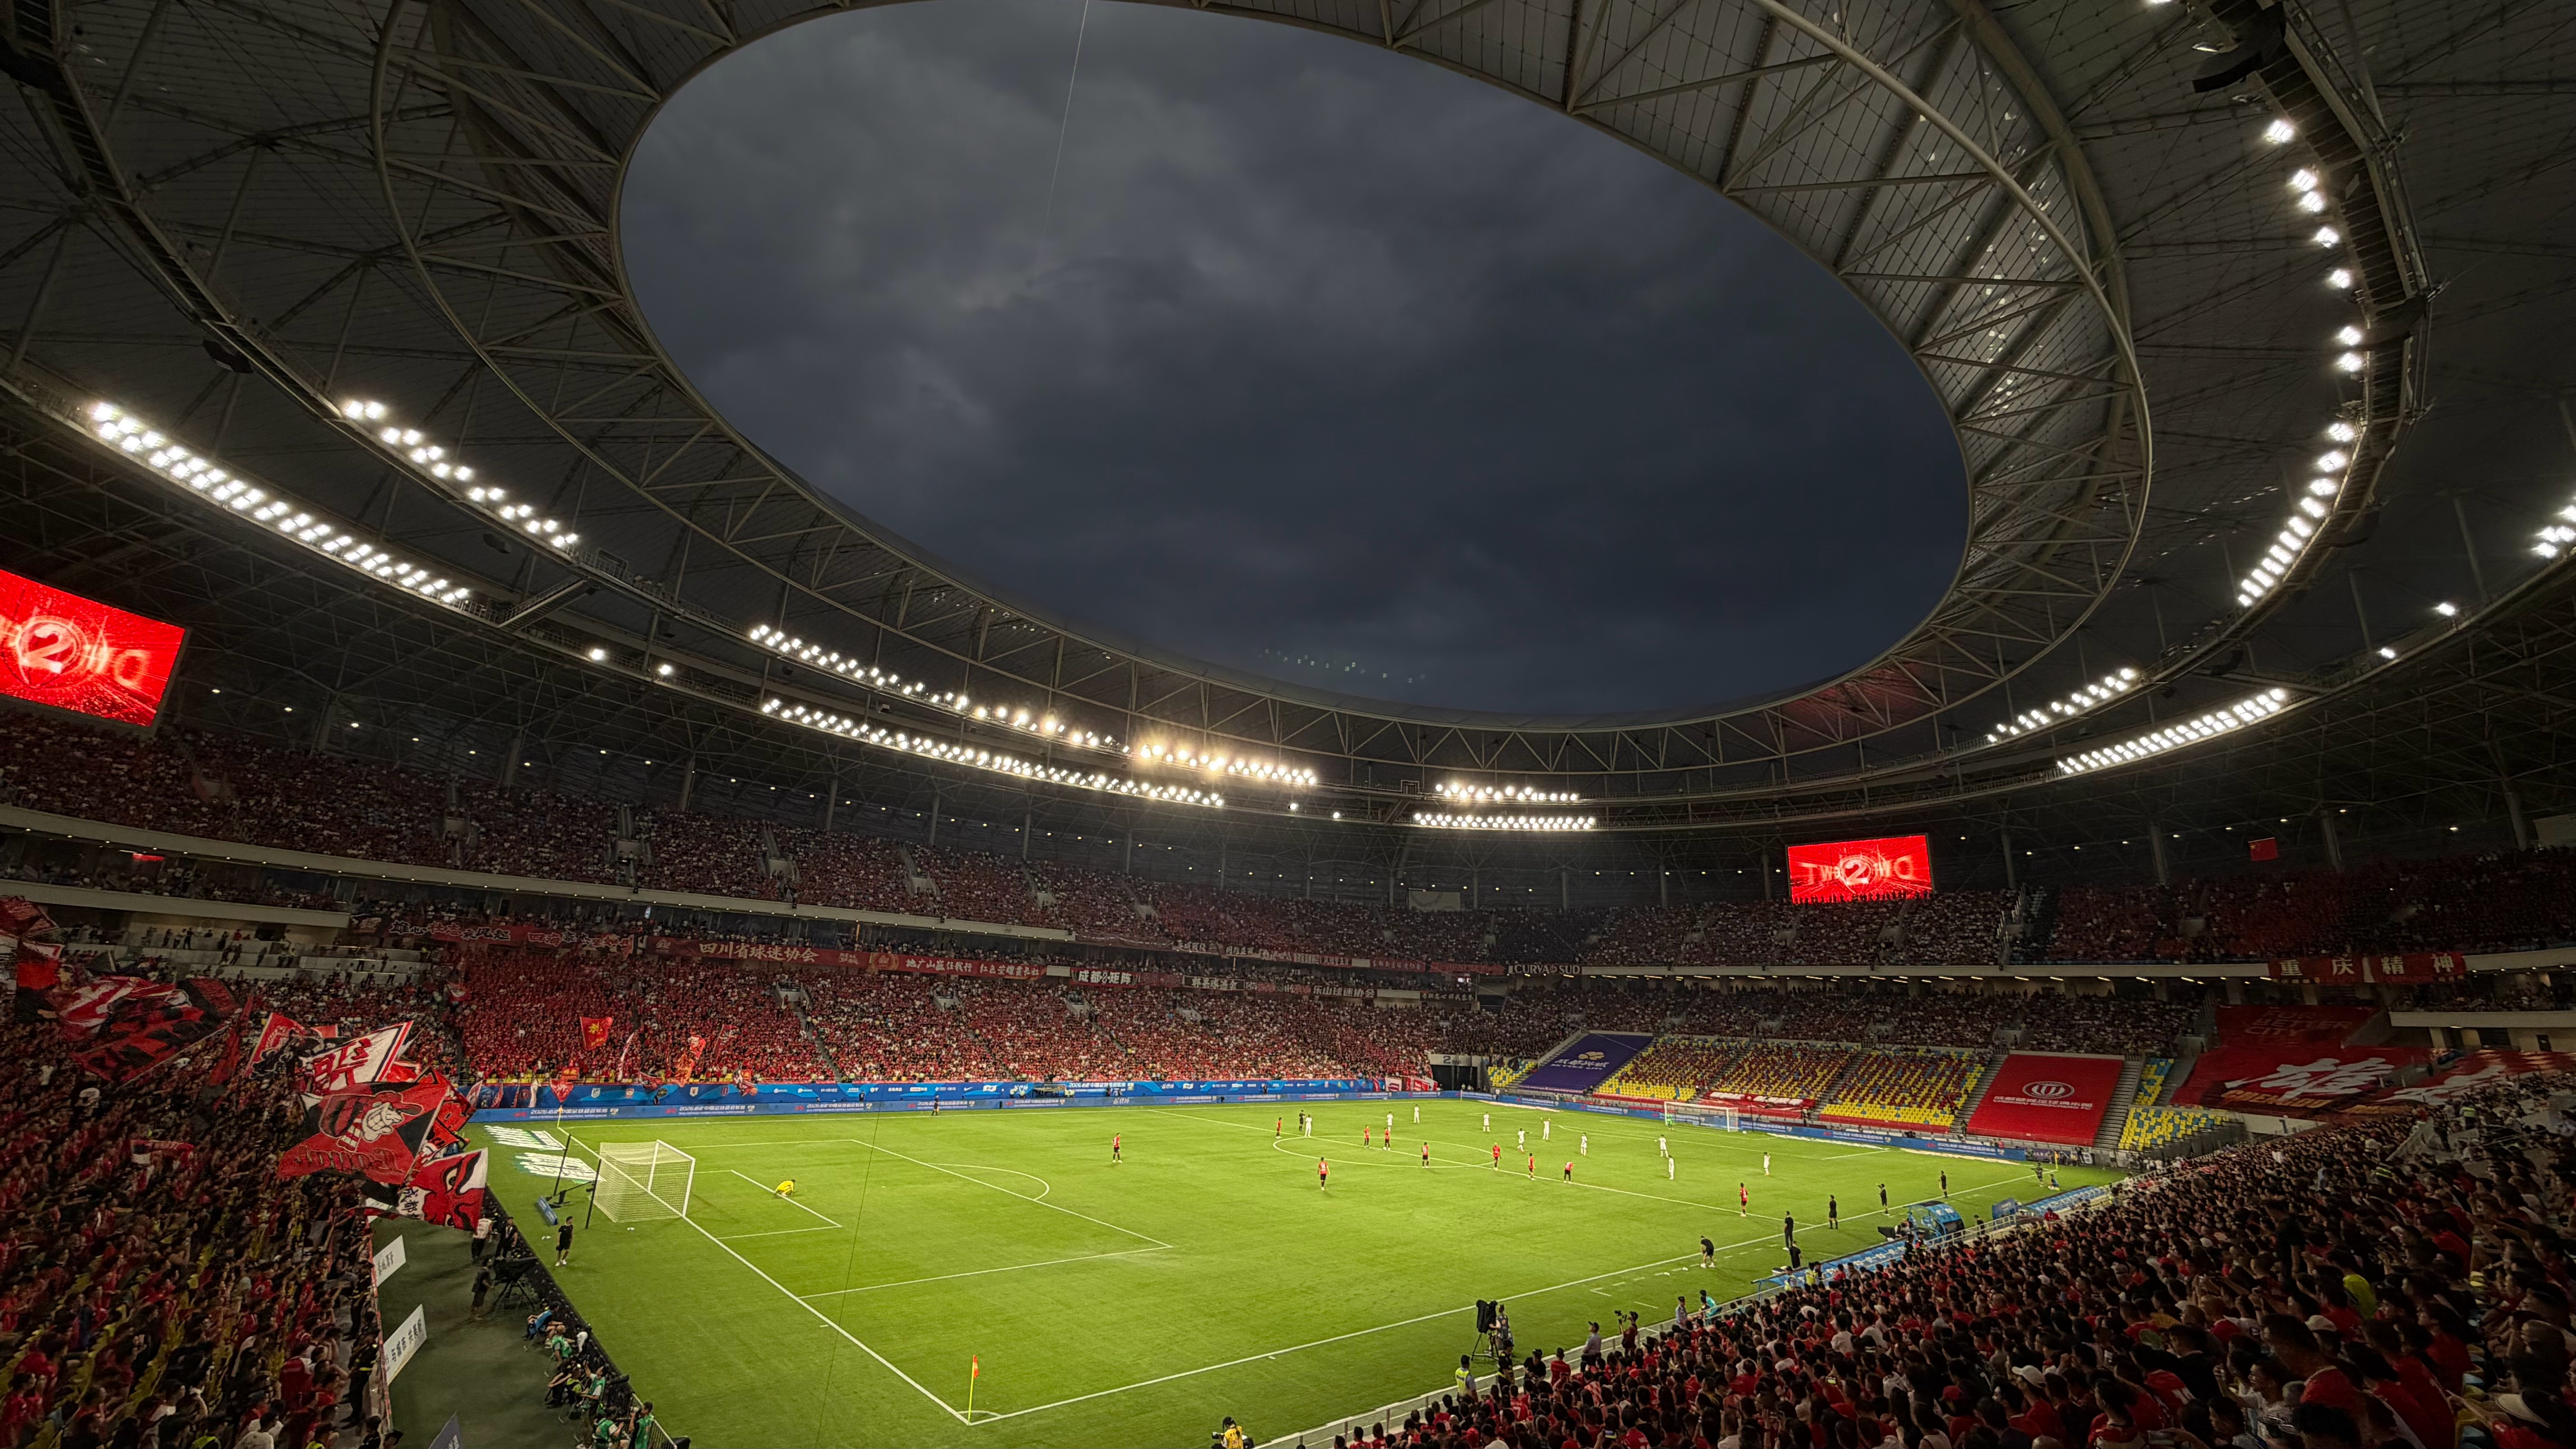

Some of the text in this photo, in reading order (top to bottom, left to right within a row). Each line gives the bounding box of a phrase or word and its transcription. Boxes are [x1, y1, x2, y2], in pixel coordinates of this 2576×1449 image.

[1845, 859, 1870, 885] 2
[699, 942, 819, 963] 四川省球迷协会
[1514, 965, 1580, 975] CURVA SUD
[2279, 953, 2455, 976] 重庆精神
[1313, 985, 1375, 998] 乐山球迷协会
[2245, 1026, 2302, 1036] CITY
[2253, 1019, 2352, 1030] BETTER
